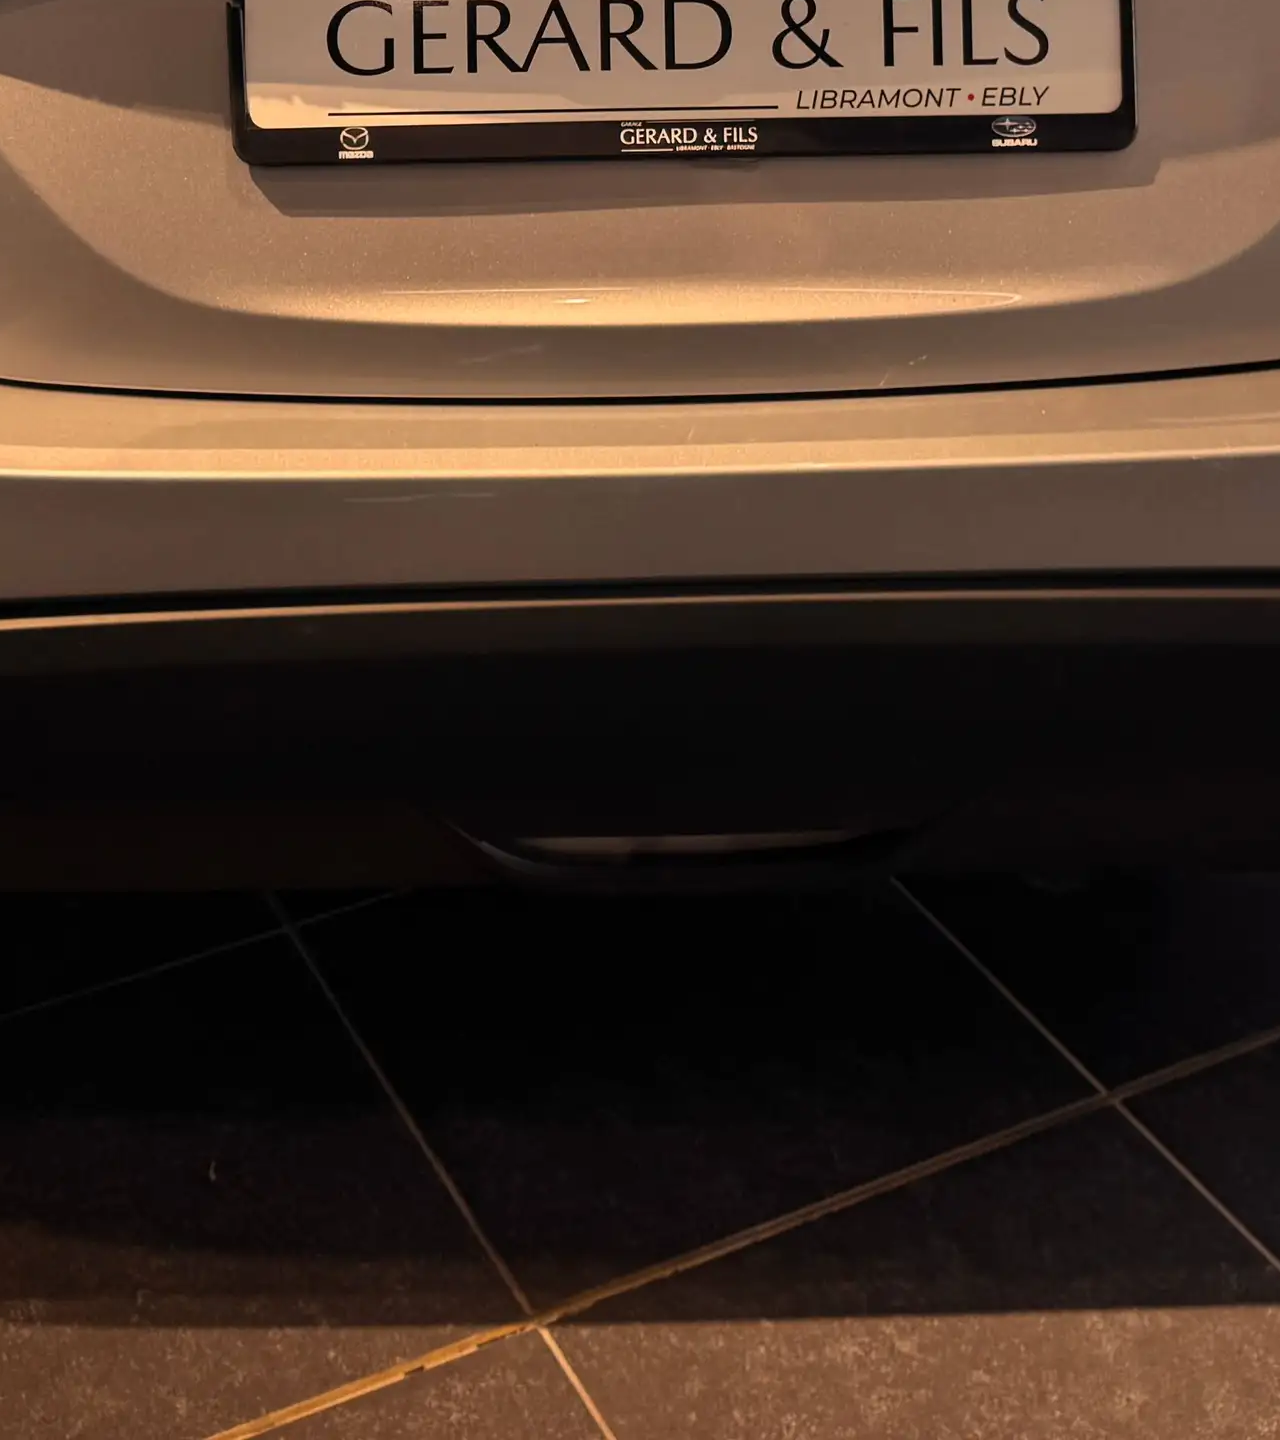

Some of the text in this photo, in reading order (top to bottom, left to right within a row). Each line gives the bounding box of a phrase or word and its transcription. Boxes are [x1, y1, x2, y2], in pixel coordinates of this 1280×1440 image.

[796, 85, 1051, 110] LIBRAMONT EBLY
[619, 126, 759, 145] GERARD & FILS
[991, 137, 1039, 147] SUBARU
